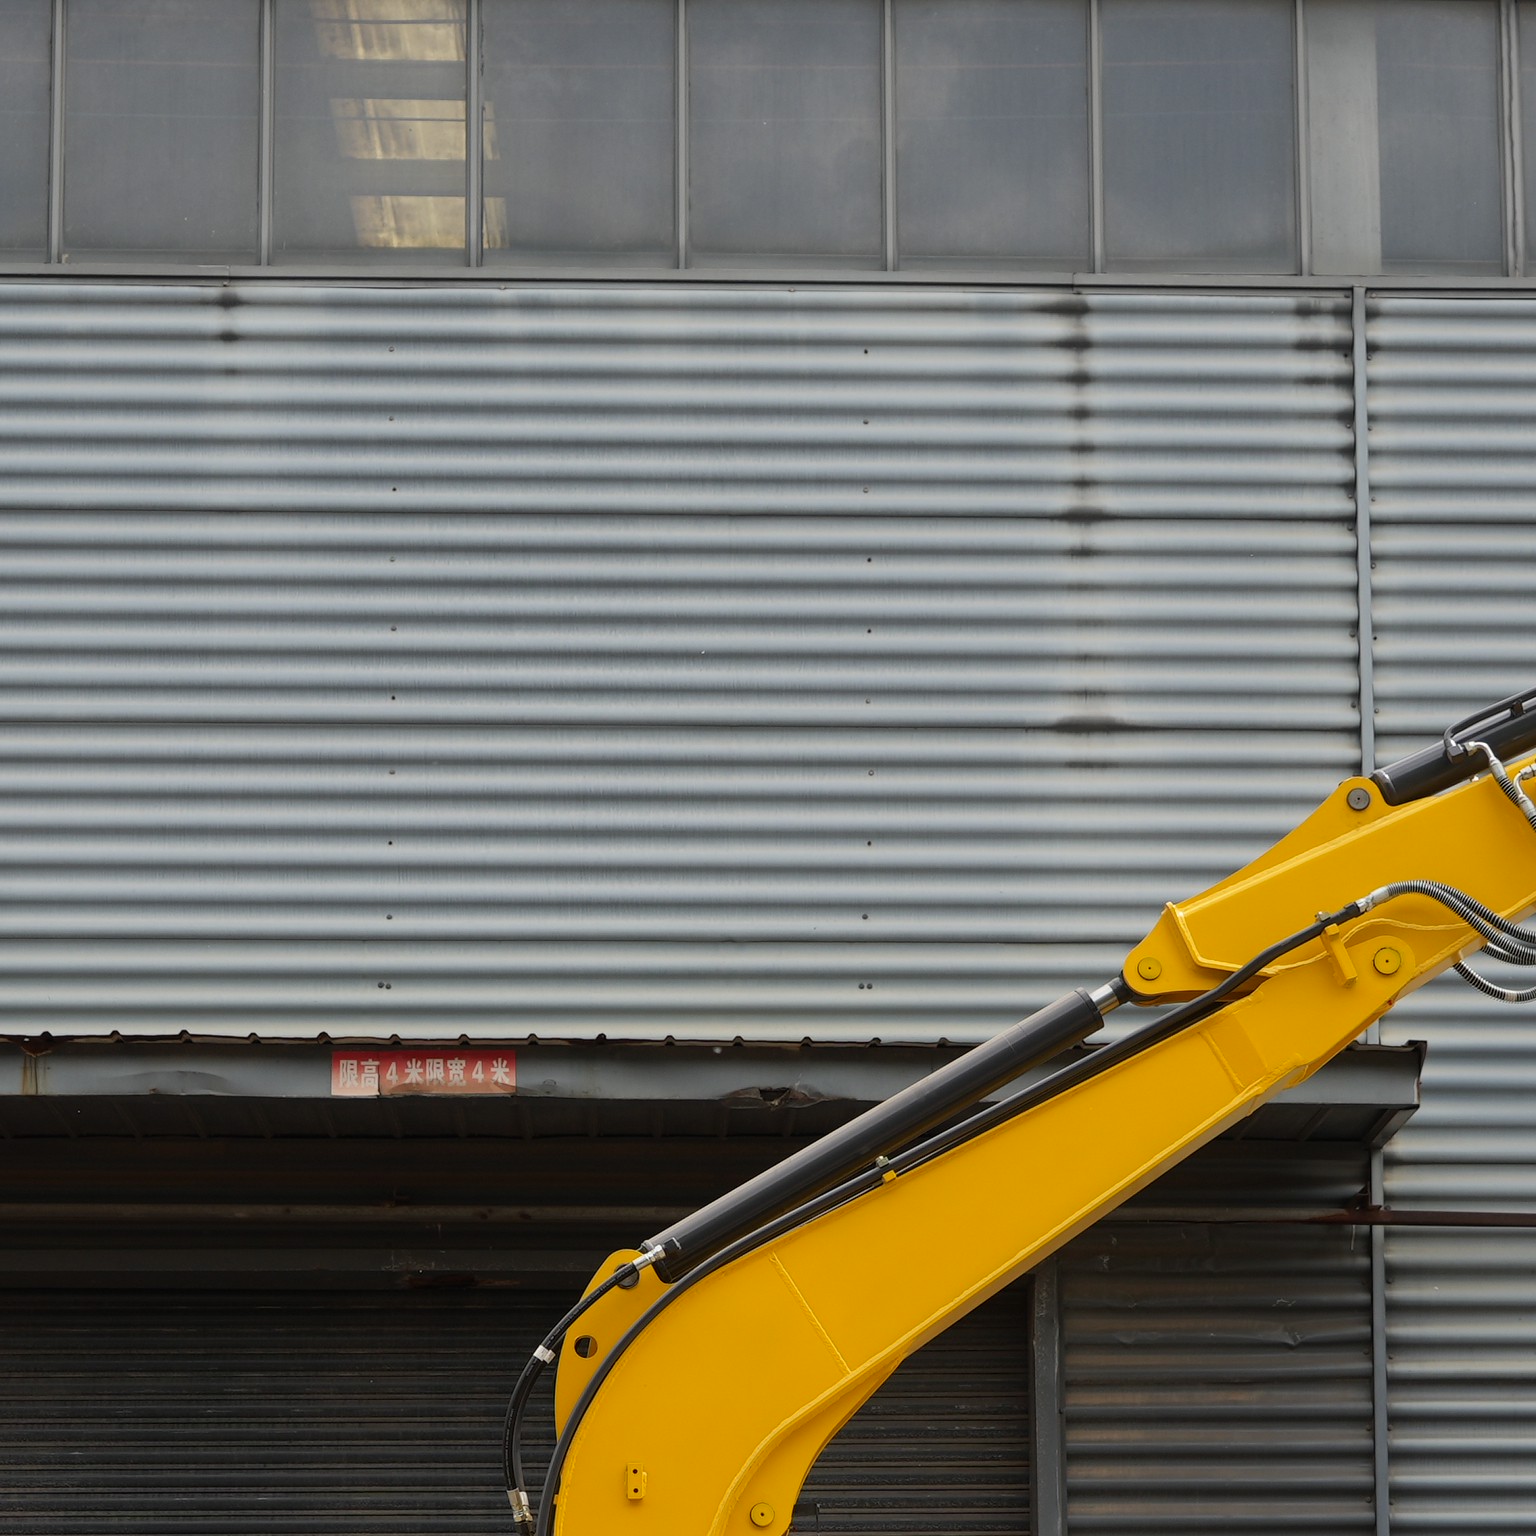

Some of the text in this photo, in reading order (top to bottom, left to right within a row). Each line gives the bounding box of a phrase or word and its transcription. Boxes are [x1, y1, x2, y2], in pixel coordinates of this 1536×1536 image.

[339, 1057, 510, 1089] 限高4米限宽4米
